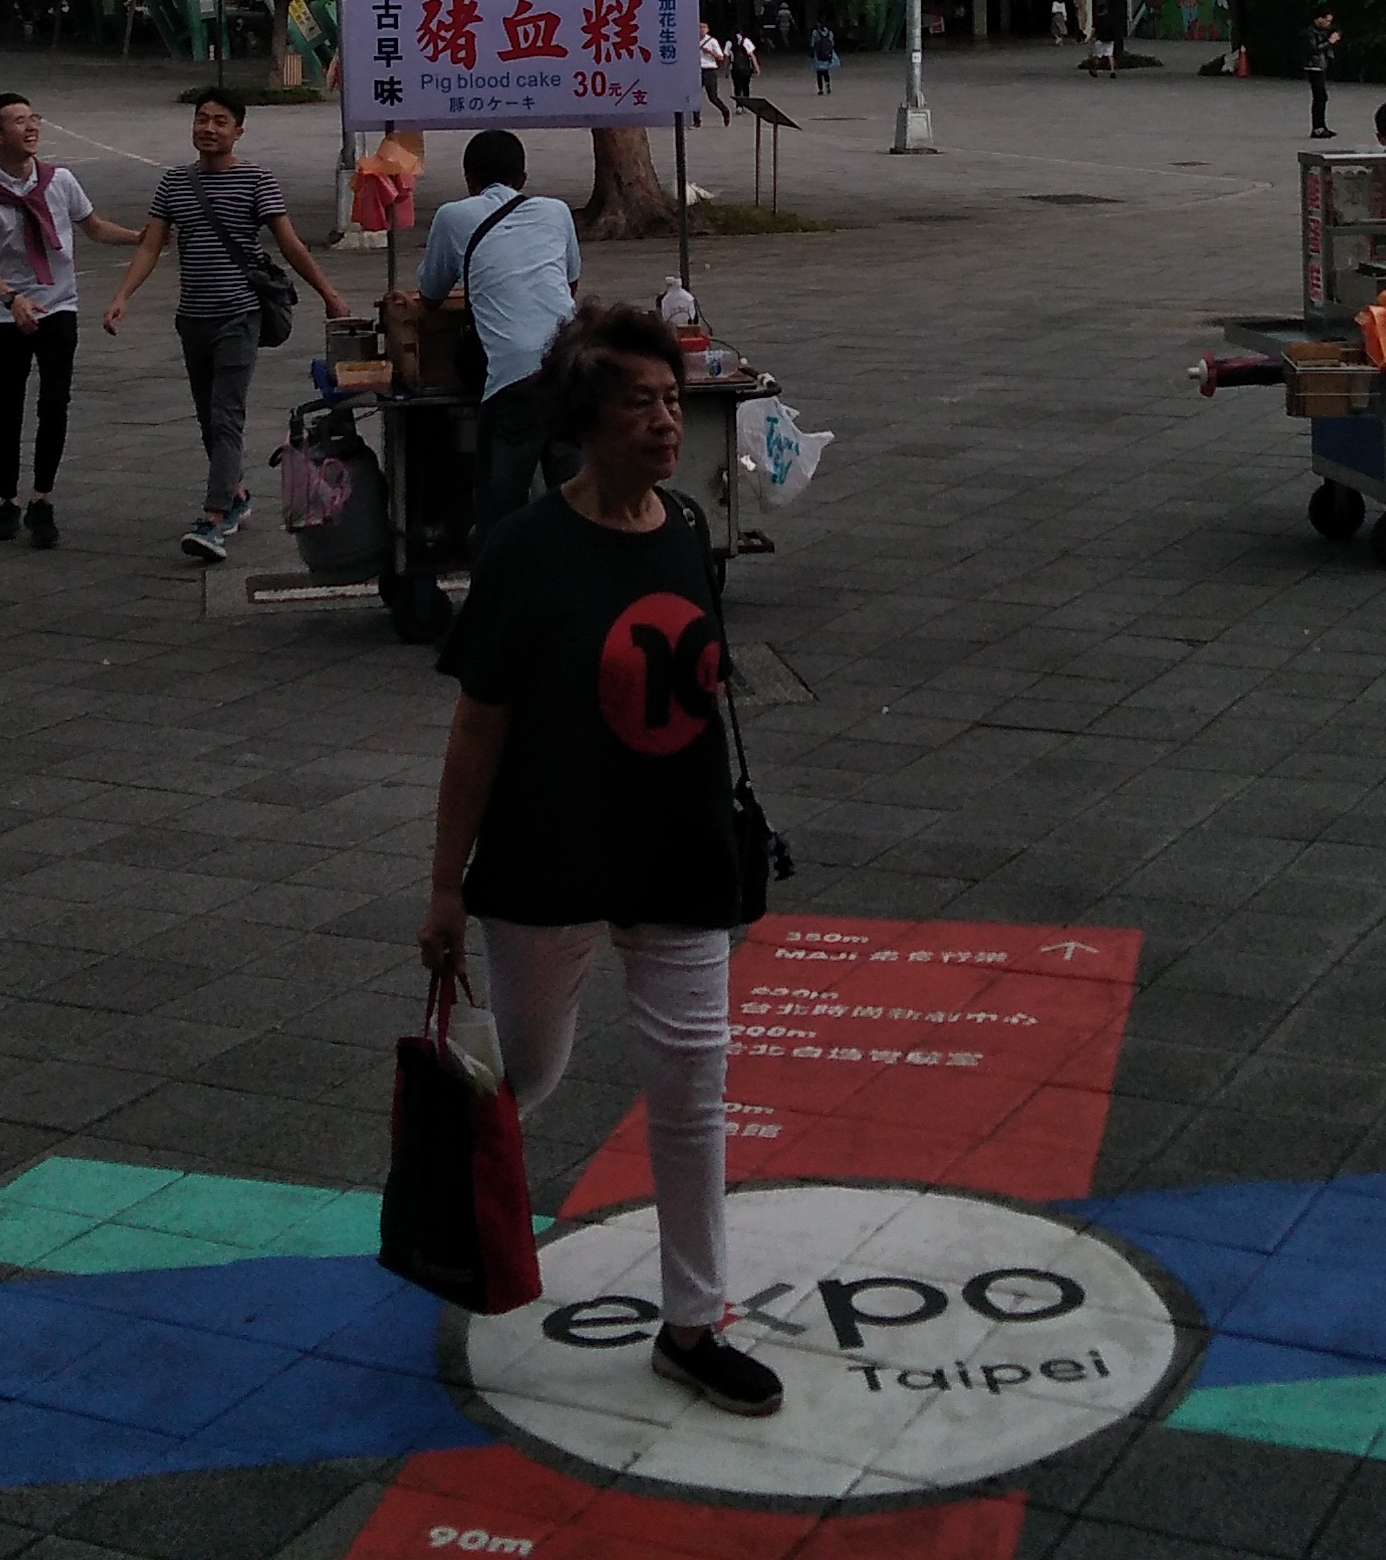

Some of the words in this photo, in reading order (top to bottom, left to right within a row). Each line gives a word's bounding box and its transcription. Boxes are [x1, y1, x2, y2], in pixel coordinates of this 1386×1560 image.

[371, 0, 404, 108] 古早味
[420, 74, 452, 93] Pig
[457, 71, 511, 89] blood
[515, 71, 562, 88] cake
[449, 95, 536, 113] 豚のケーキ
[774, 948, 859, 962] MAJI
[724, 1101, 775, 1115] 0m
[848, 1347, 1112, 1396] Taipei
[428, 1525, 534, 1558] 90m
